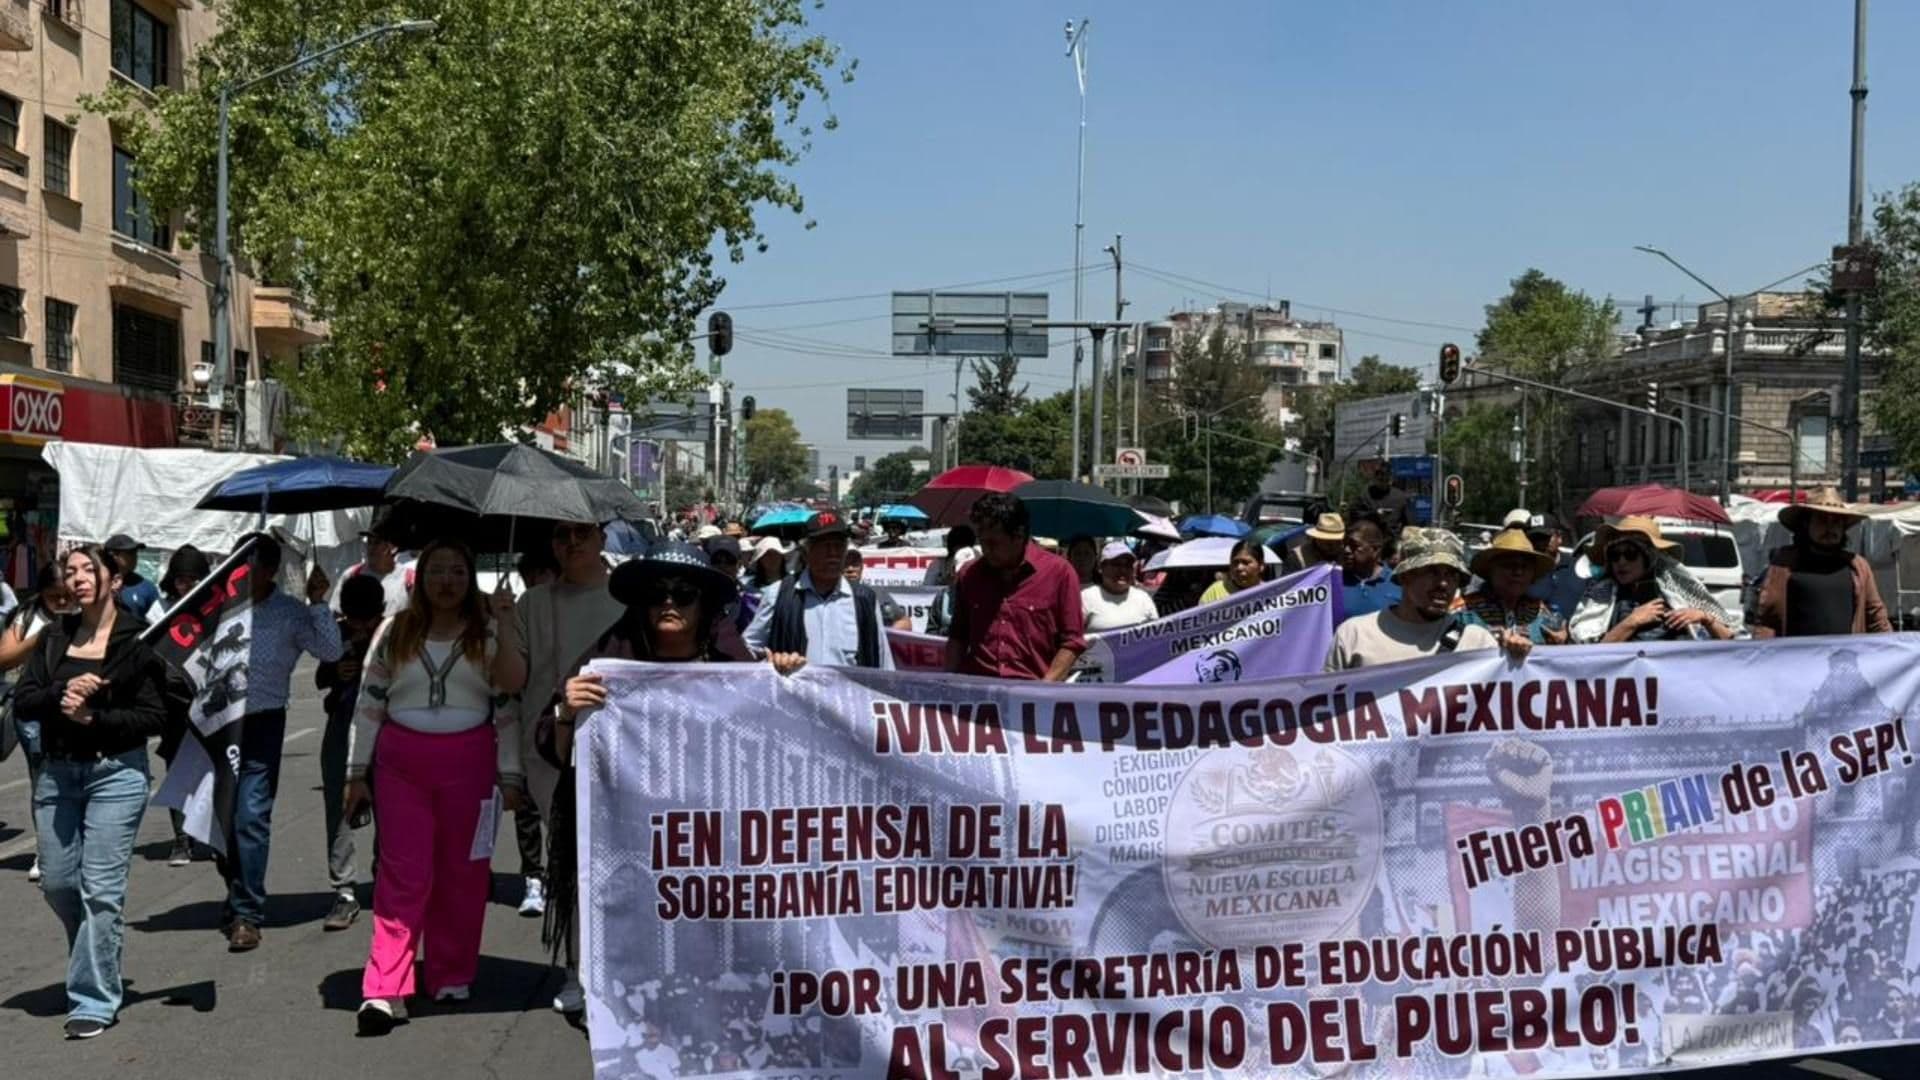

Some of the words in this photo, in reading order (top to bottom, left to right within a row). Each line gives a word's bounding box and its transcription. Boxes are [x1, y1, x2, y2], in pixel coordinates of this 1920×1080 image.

[14, 392, 62, 433] OXXO
[1120, 620, 1175, 646] ¡VIVA
[1180, 615, 1204, 631] EL
[1208, 586, 1328, 625] HUMANISMO
[1170, 619, 1281, 655] MEXICANO!
[872, 701, 1008, 754] ¡VIVA
[1022, 701, 1085, 754] LA
[1099, 684, 1388, 752] PEDAGOGÍA
[1397, 677, 1658, 737] MEXICANA!
[1457, 814, 1595, 889] ¡Fuera
[1599, 773, 1715, 849] PRIAN
[1720, 763, 1775, 815] de
[1779, 749, 1827, 798] la
[1828, 717, 1913, 785] SEP!
[651, 811, 722, 871] ¡EN
[740, 805, 931, 867] DEFENSA
[948, 805, 1002, 859] DE
[1017, 804, 1069, 859] LA
[1096, 819, 1160, 844] DIGNAS
[1211, 815, 1338, 848] COMITÉS
[1188, 874, 1260, 897] NUEVA
[1265, 865, 1356, 890] ESCUELA
[1569, 840, 1806, 889] MAGISTERIAL
[657, 864, 862, 921] SOBERANÍA
[874, 864, 1075, 913] EDUCATIVA!
[1205, 887, 1342, 918] MEXICANA
[1598, 887, 1786, 928] MEXICANO
[772, 967, 881, 1017] ¡POR
[896, 961, 987, 1011] UNA
[1000, 949, 1242, 1004] SECRETARÍA
[1255, 943, 1306, 989] DE
[1319, 924, 1543, 985] EDUCACIÓN
[1555, 920, 1723, 974] PÚBLICA
[886, 1023, 962, 1080] AL
[978, 1005, 1247, 1080] SERVICIO
[1268, 997, 1377, 1066] DEL
[1395, 983, 1640, 1058] PUEBLO!
